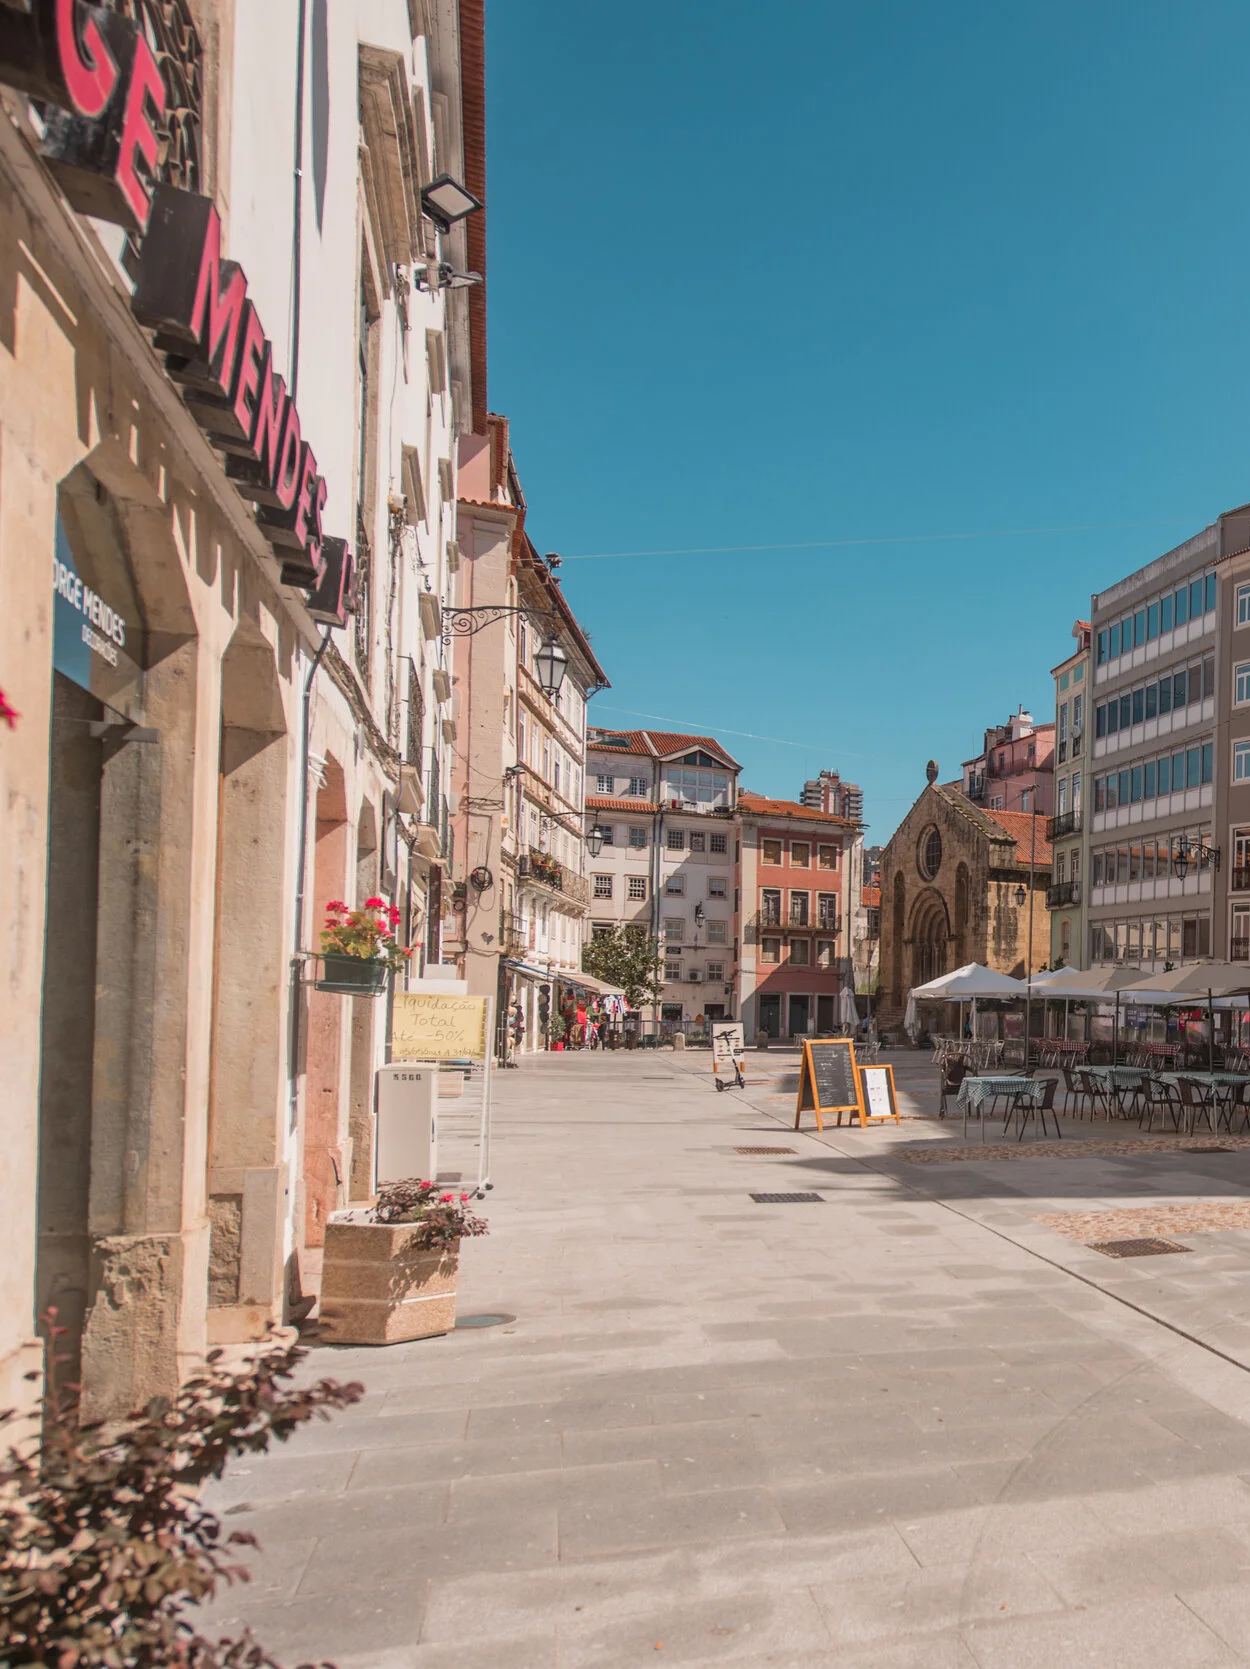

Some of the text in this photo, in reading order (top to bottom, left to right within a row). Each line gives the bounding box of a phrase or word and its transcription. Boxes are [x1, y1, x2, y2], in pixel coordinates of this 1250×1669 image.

[189, 203, 328, 592] MENDES
[82, 585, 126, 647] MENDES
[410, 1013, 457, 1028] Total
[426, 1029, 465, 1042] -50%
